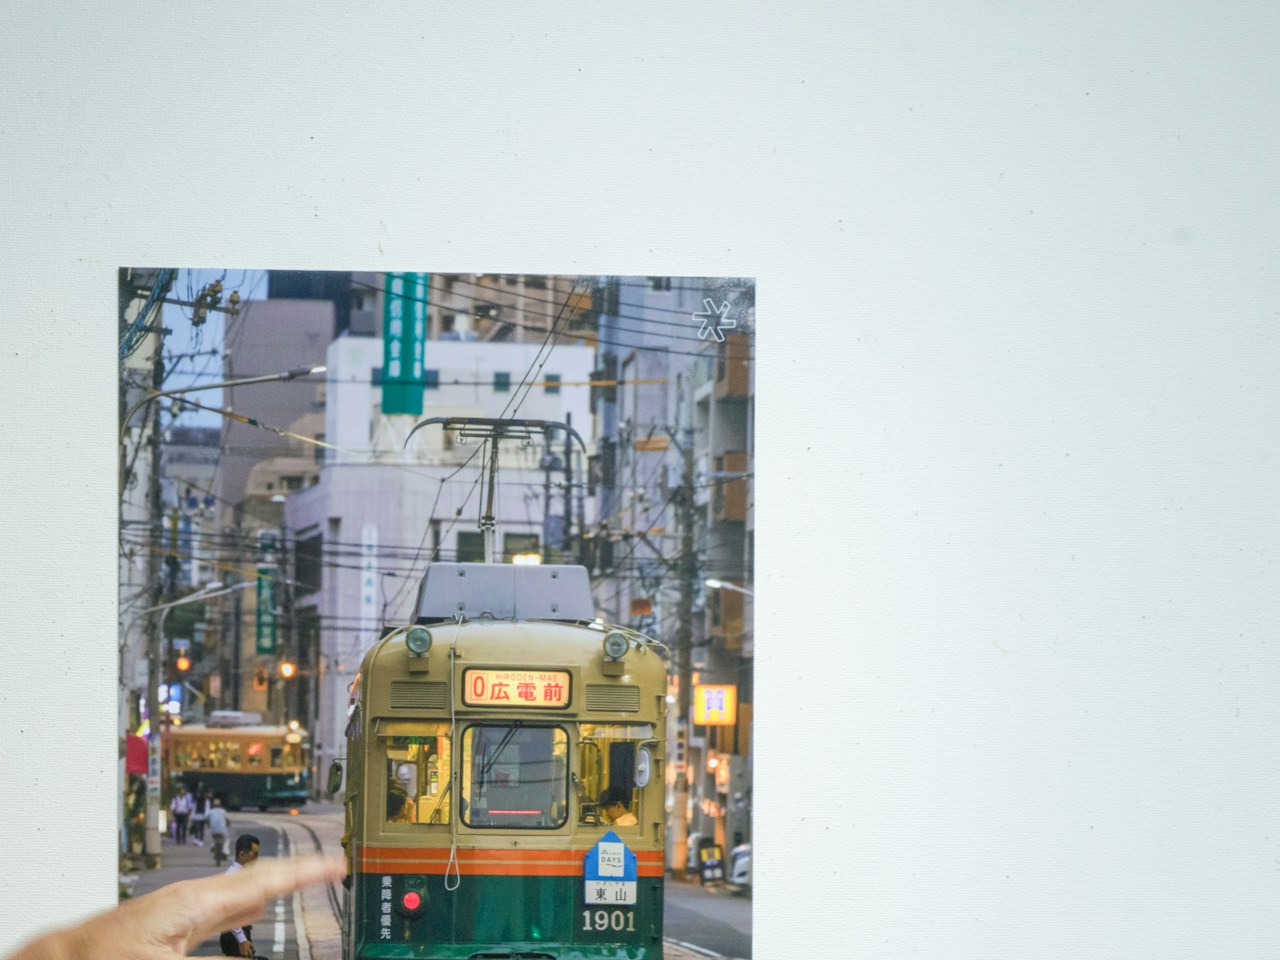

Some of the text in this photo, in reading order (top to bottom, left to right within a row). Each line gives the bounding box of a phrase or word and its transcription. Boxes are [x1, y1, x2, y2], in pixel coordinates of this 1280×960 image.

[473, 675, 485, 698] 0
[495, 673, 559, 682] HIRODEN-MAE
[490, 681, 564, 702] 広電前
[595, 888, 628, 902] 東山
[380, 875, 392, 940] 乗降者優先
[582, 910, 636, 932] 1901
